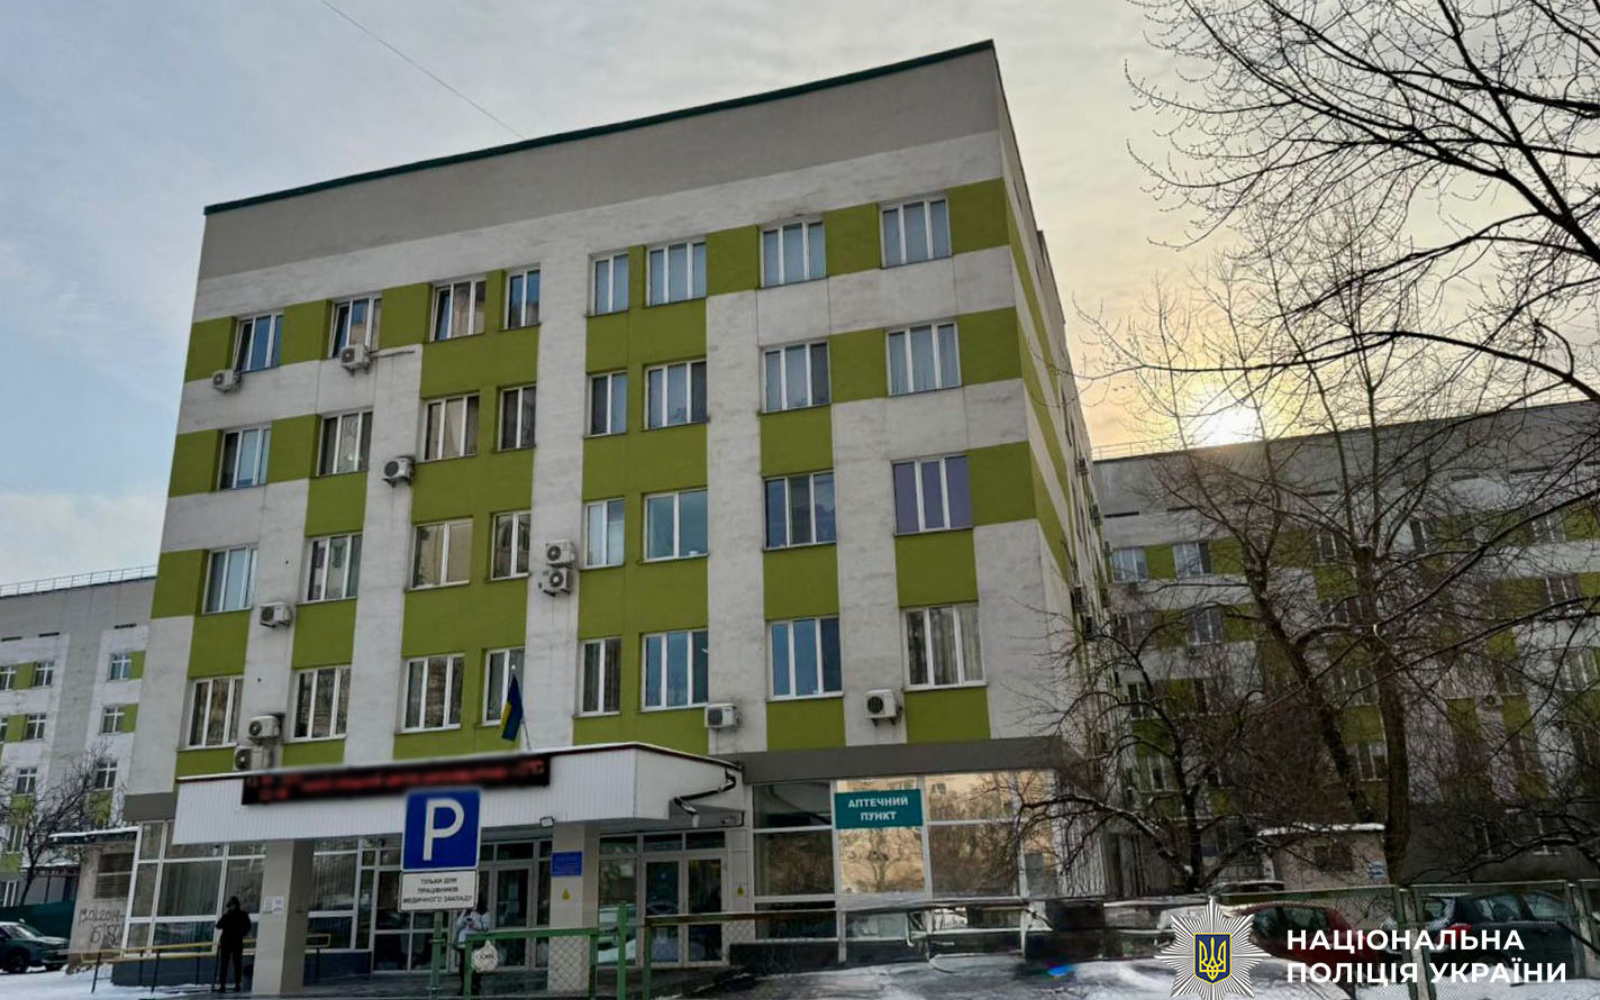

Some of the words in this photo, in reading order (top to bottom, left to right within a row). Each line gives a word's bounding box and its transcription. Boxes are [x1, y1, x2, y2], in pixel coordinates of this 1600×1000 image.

[848, 795, 909, 808] АПТЕЧНИЙ
[860, 811, 897, 821] ПУНКТ
[423, 798, 464, 861] P
